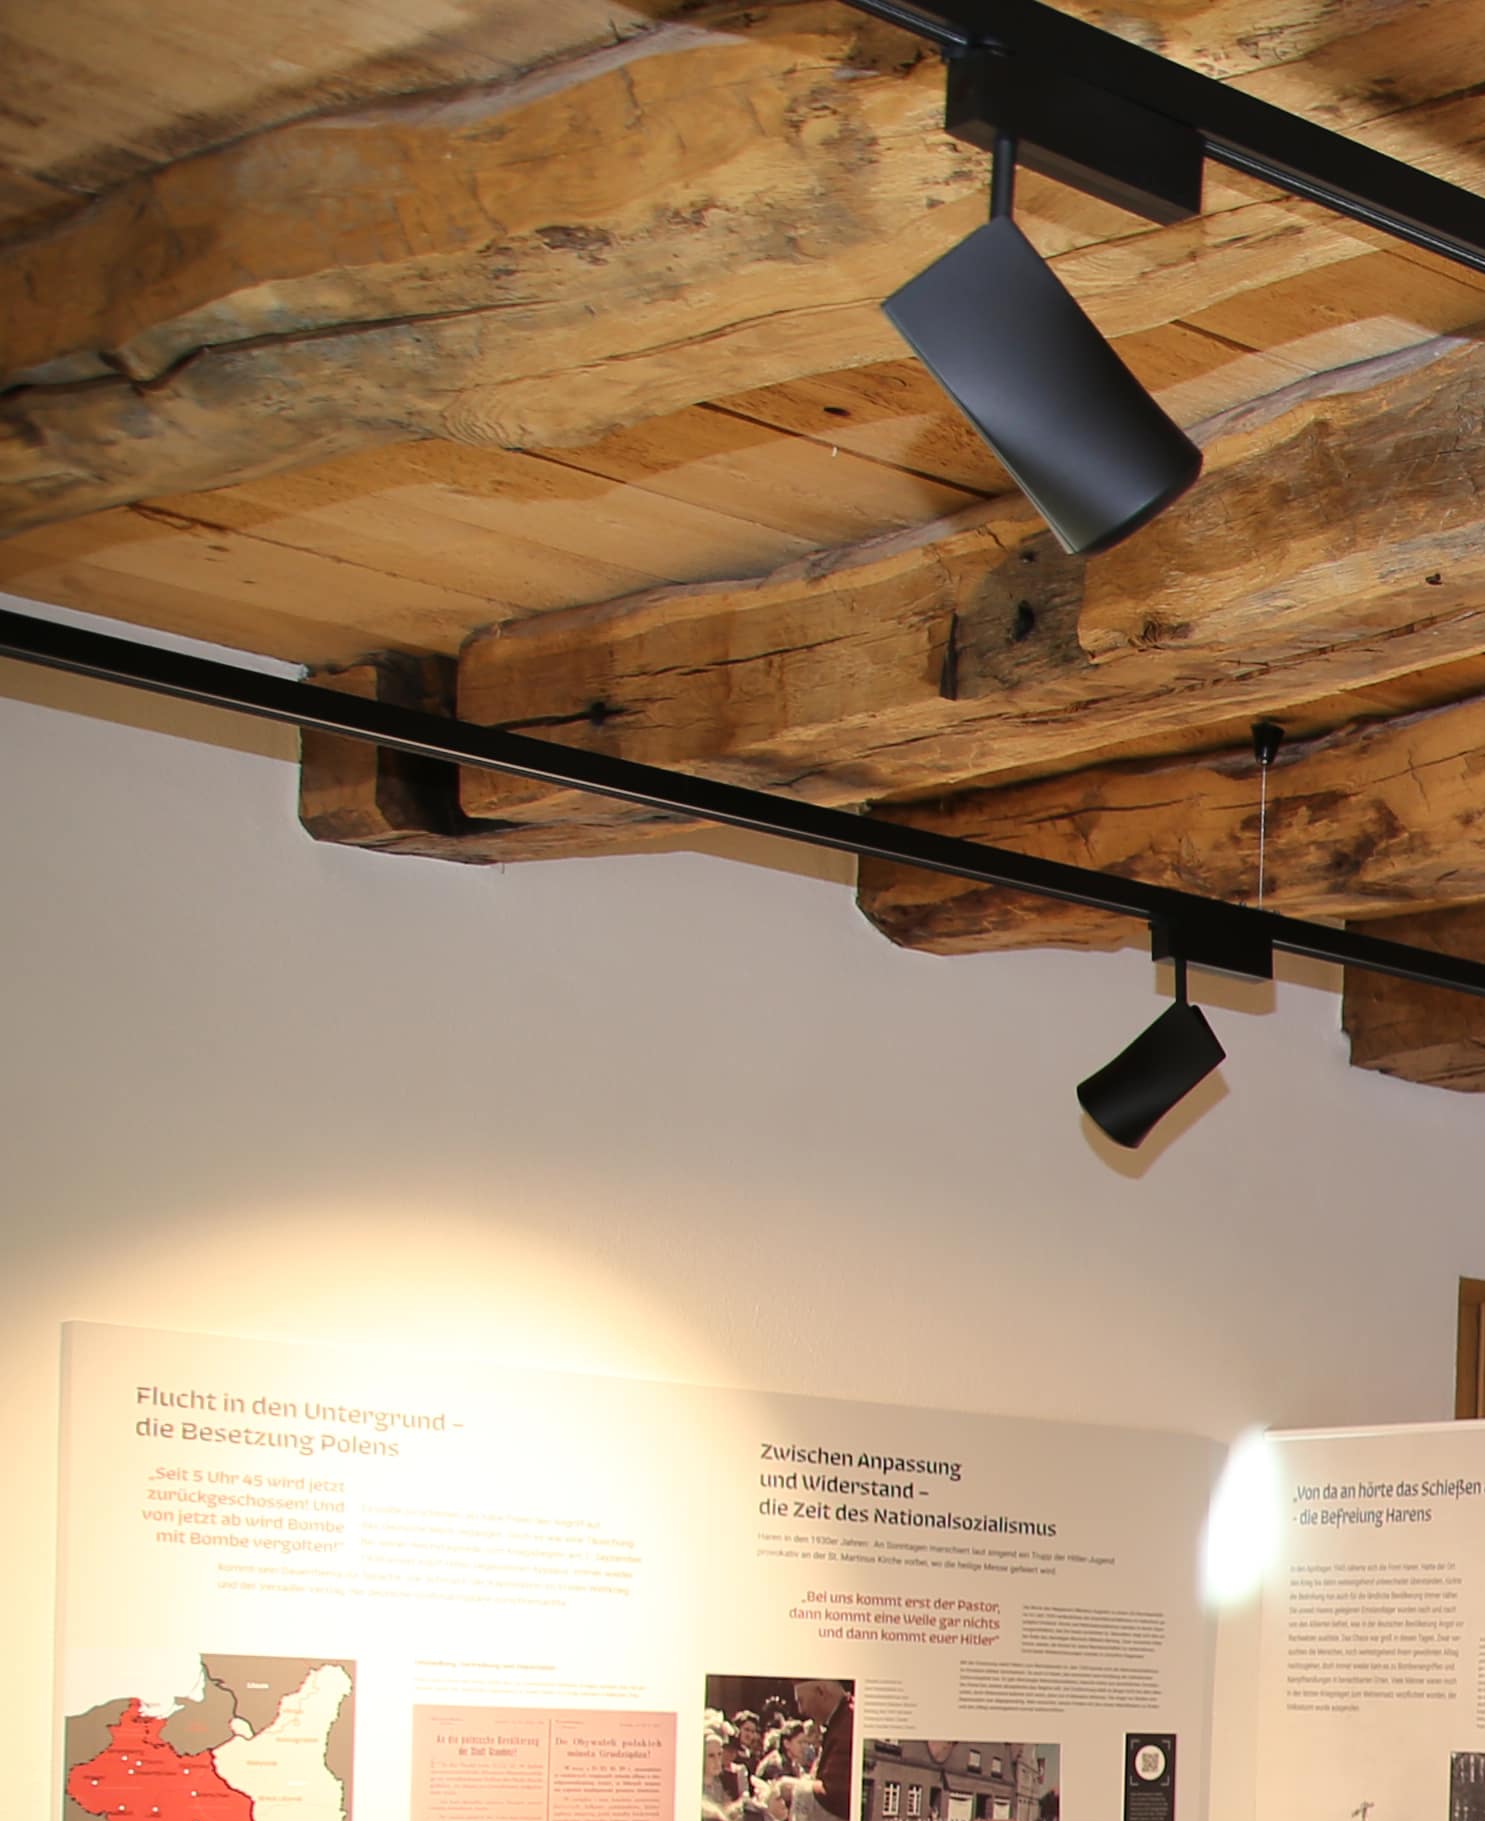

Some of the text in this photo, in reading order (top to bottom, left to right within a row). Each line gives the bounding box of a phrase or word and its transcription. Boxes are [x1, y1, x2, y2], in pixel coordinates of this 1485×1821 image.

[136, 1386, 216, 1411] Flucht
[223, 1393, 244, 1413] in
[251, 1396, 297, 1418] den
[304, 1402, 445, 1431] Untergrund
[136, 1417, 399, 1456] die Besetzung Polens
[761, 1443, 961, 1481] Zwischen Anpassung
[192, 1469, 203, 1482] 5
[208, 1471, 239, 1484] Uhr
[242, 1474, 263, 1487] 45
[266, 1477, 304, 1489] wird
[309, 1480, 344, 1493] jetzt
[760, 1472, 796, 1489] und
[802, 1475, 913, 1498] Widerstand
[1322, 1483, 1337, 1499] da
[1340, 1485, 1355, 1499] an
[1358, 1481, 1393, 1498] hörte
[1396, 1480, 1418, 1497] das
[1421, 1479, 1481, 1499] Schießen
[147, 1488, 344, 1512] zurückgeschossen! Und
[141, 1509, 344, 1532] von jetzt ab wird Bombe
[759, 1498, 1056, 1536] die Zeit des Nationalsozialismus
[1299, 1508, 1318, 1525] die
[1320, 1507, 1383, 1528] Befreiung
[1385, 1508, 1431, 1522] Harens
[156, 1530, 185, 1543] mit
[190, 1532, 249, 1547] Bombe
[830, 1593, 853, 1604] uns
[856, 1593, 901, 1607] kommt
[905, 1598, 930, 1608] erst
[933, 1598, 955, 1609] der
[958, 1600, 1000, 1614] Pastor,
[789, 1607, 1000, 1630] dann kommt eine Weile gar nichts
[818, 1626, 843, 1638] und
[846, 1627, 878, 1640] dann
[881, 1629, 926, 1643] kommt
[929, 1633, 958, 1644] euer
